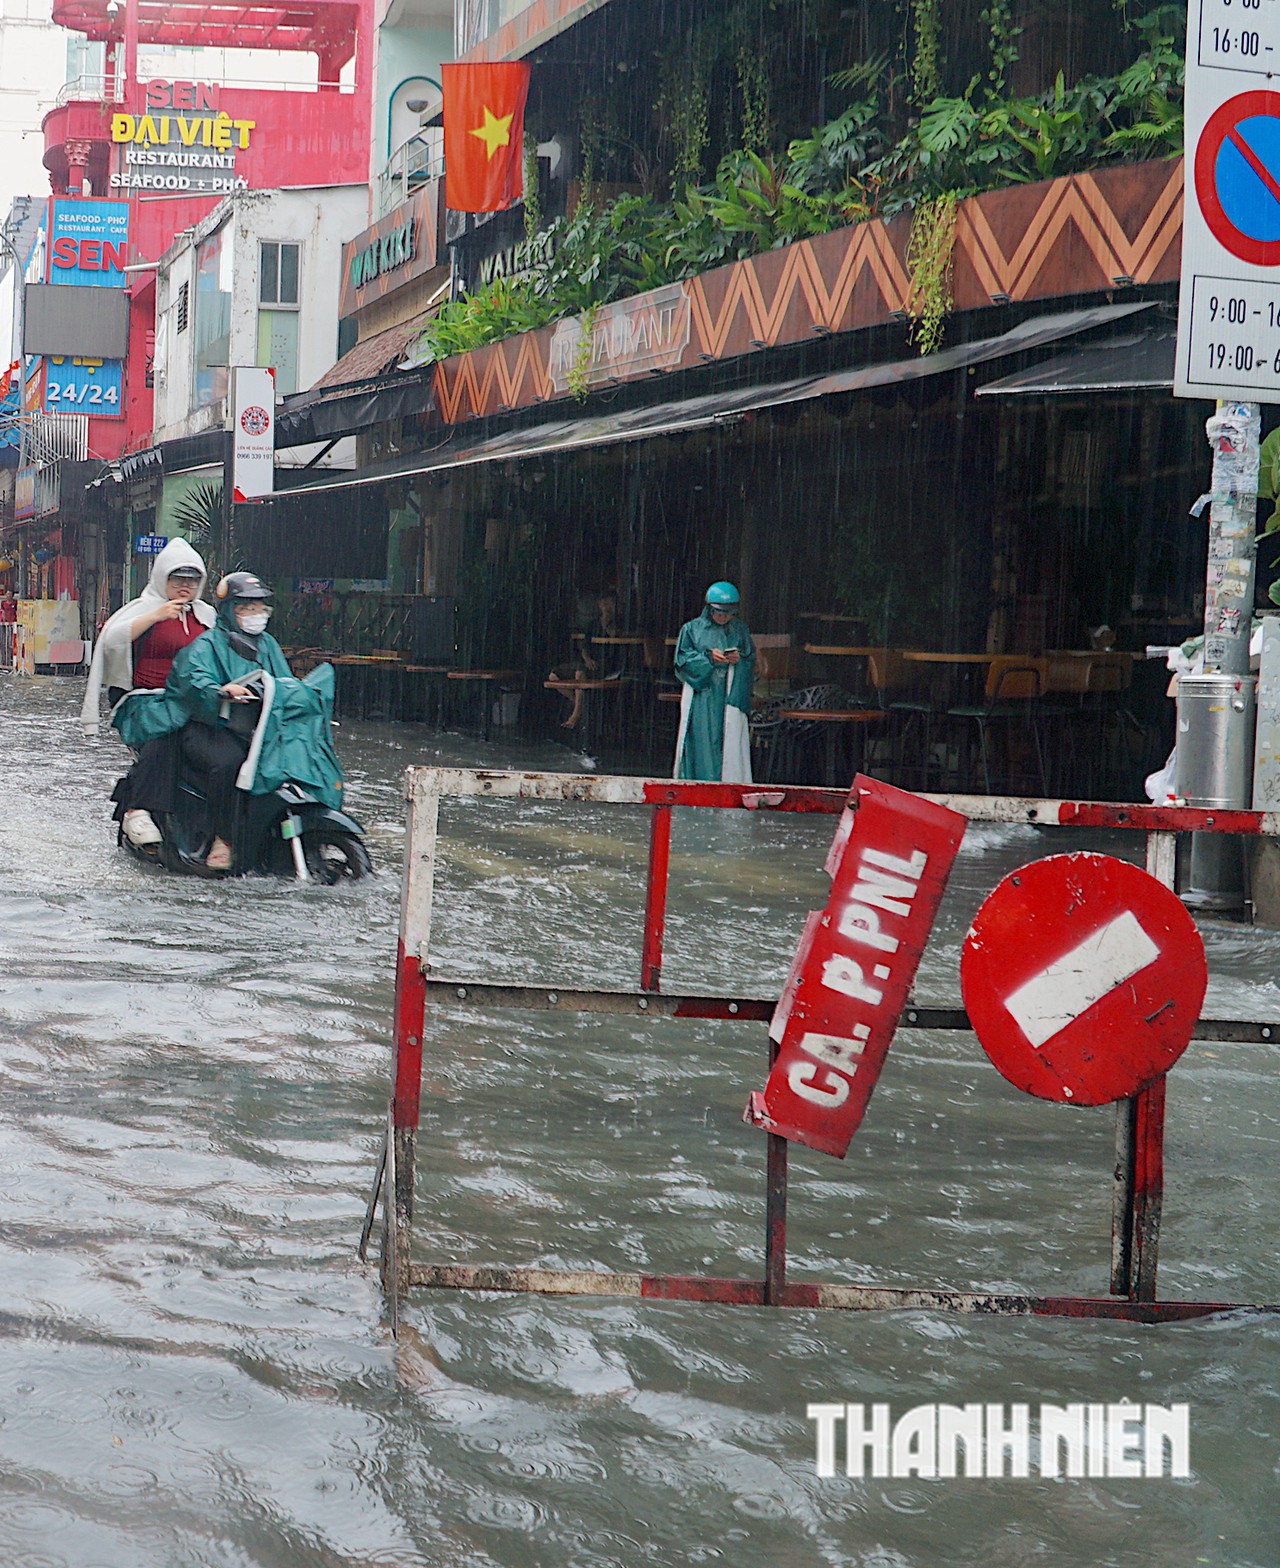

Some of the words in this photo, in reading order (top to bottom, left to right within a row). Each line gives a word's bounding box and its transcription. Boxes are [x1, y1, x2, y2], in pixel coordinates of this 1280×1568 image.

[1213, 27, 1259, 56] 16:00
[147, 79, 220, 111] SEN
[111, 113, 169, 149] ĐẠI
[176, 111, 256, 153] VIỆT
[125, 151, 236, 169] RESTAURANT
[110, 173, 191, 190] SEAFOOD
[58, 213, 101, 224] SEAFOOD
[58, 224, 106, 233] RESTAURANT
[51, 237, 127, 273] SEN
[351, 217, 415, 289] WAIKIKI
[1210, 296, 1246, 324] 9:00
[558, 307, 678, 373] RETAURANT
[1208, 343, 1254, 371] 19:00
[47, 382, 118, 405] 24/24
[787, 1023, 871, 1109] CA.
